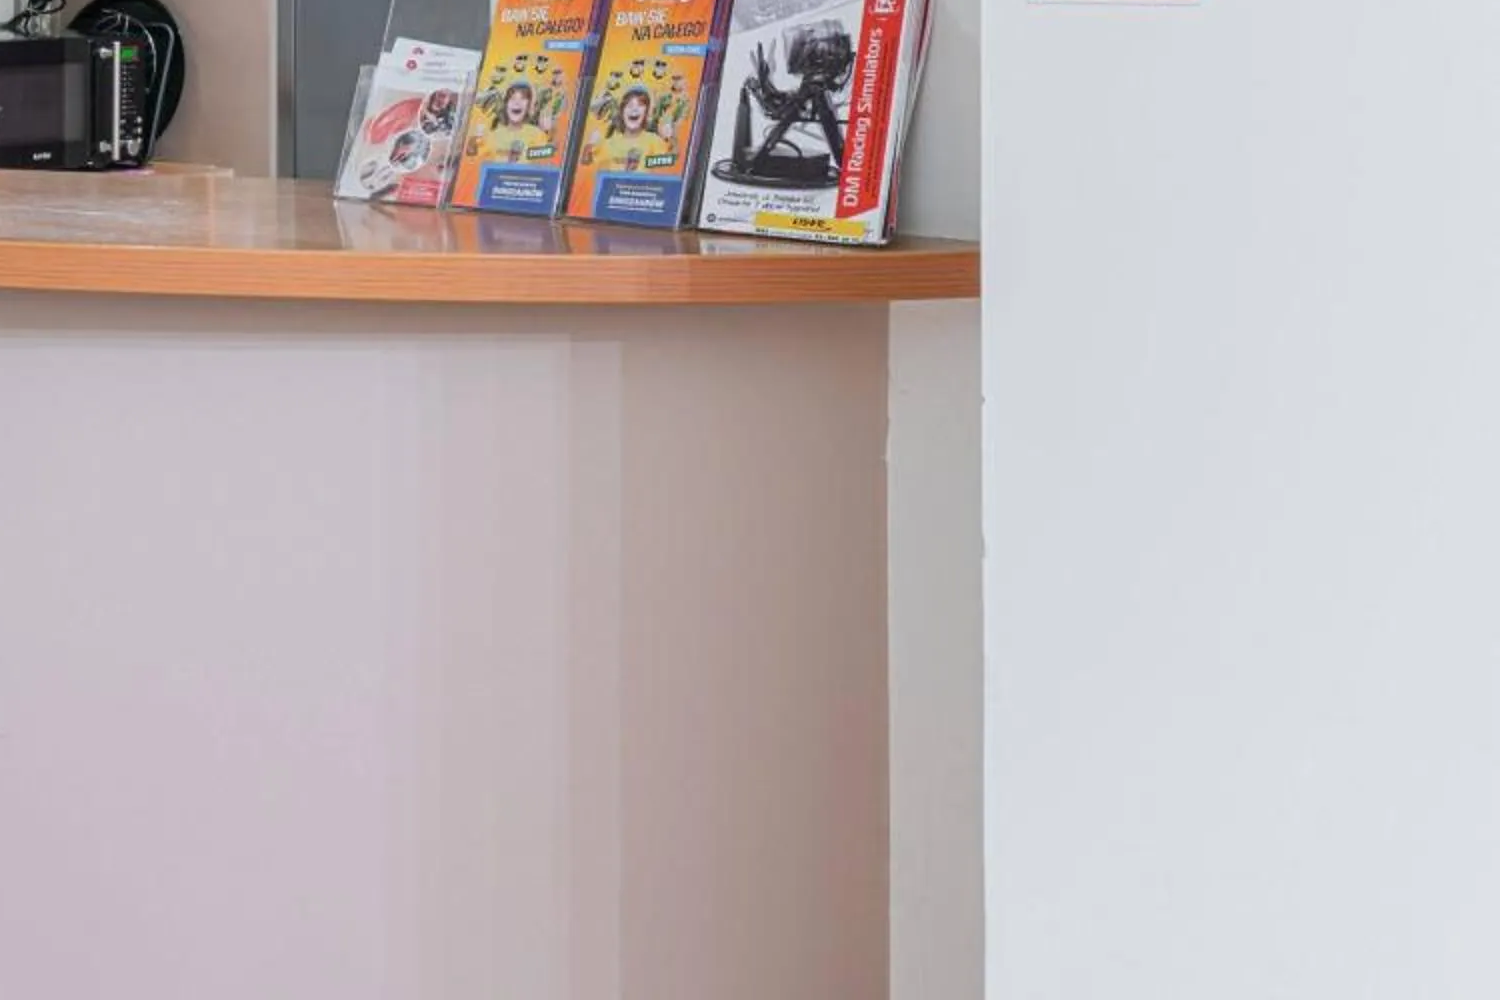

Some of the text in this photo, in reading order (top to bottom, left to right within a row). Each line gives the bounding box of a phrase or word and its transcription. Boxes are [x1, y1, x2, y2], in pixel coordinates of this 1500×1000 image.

[858, 27, 883, 113] Simulators
[848, 117, 871, 172] Racing
[843, 177, 861, 208] DM
